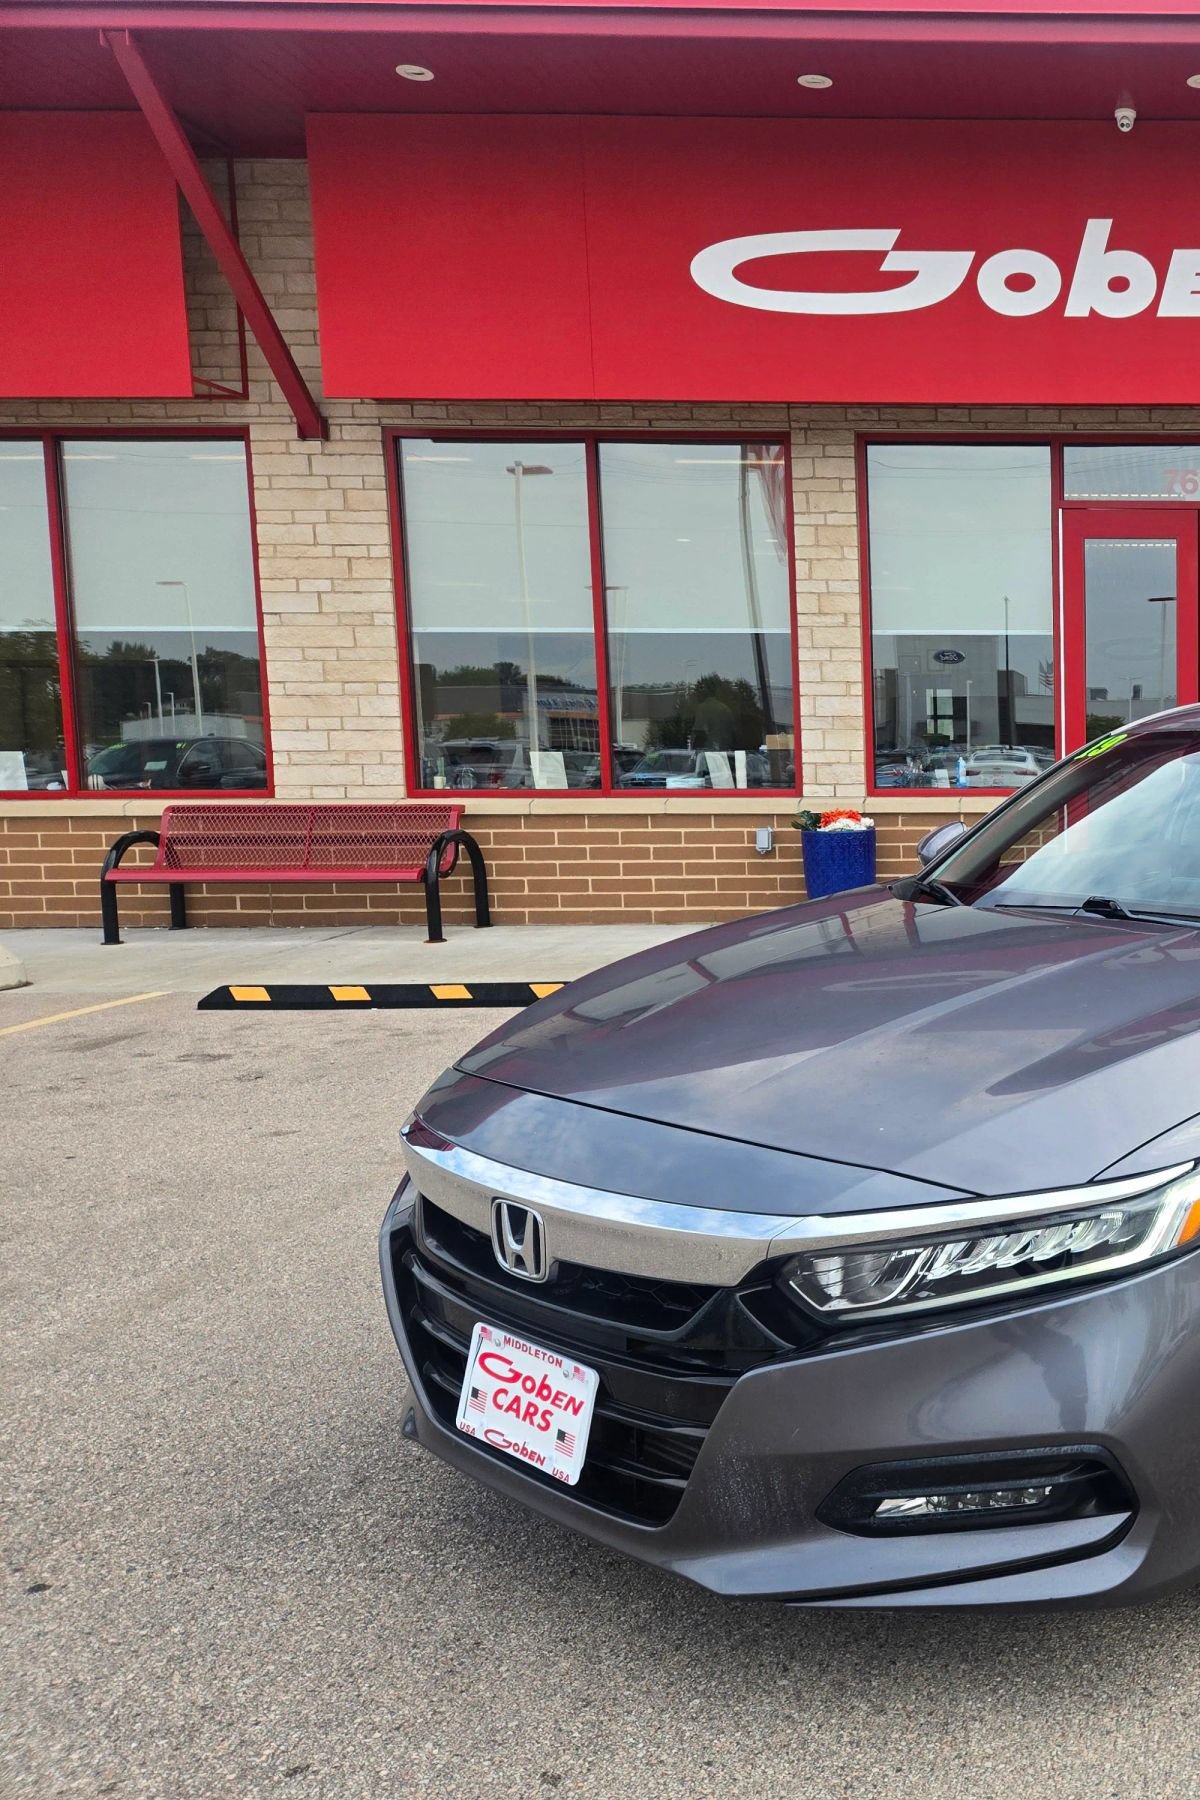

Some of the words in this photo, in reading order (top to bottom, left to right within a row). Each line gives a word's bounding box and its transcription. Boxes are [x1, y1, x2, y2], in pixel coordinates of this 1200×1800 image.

[503, 1335, 563, 1368] MIDDLETON
[492, 1388, 554, 1432] CARS
[459, 1421, 476, 1436] USA
[552, 1467, 570, 1483] USA
